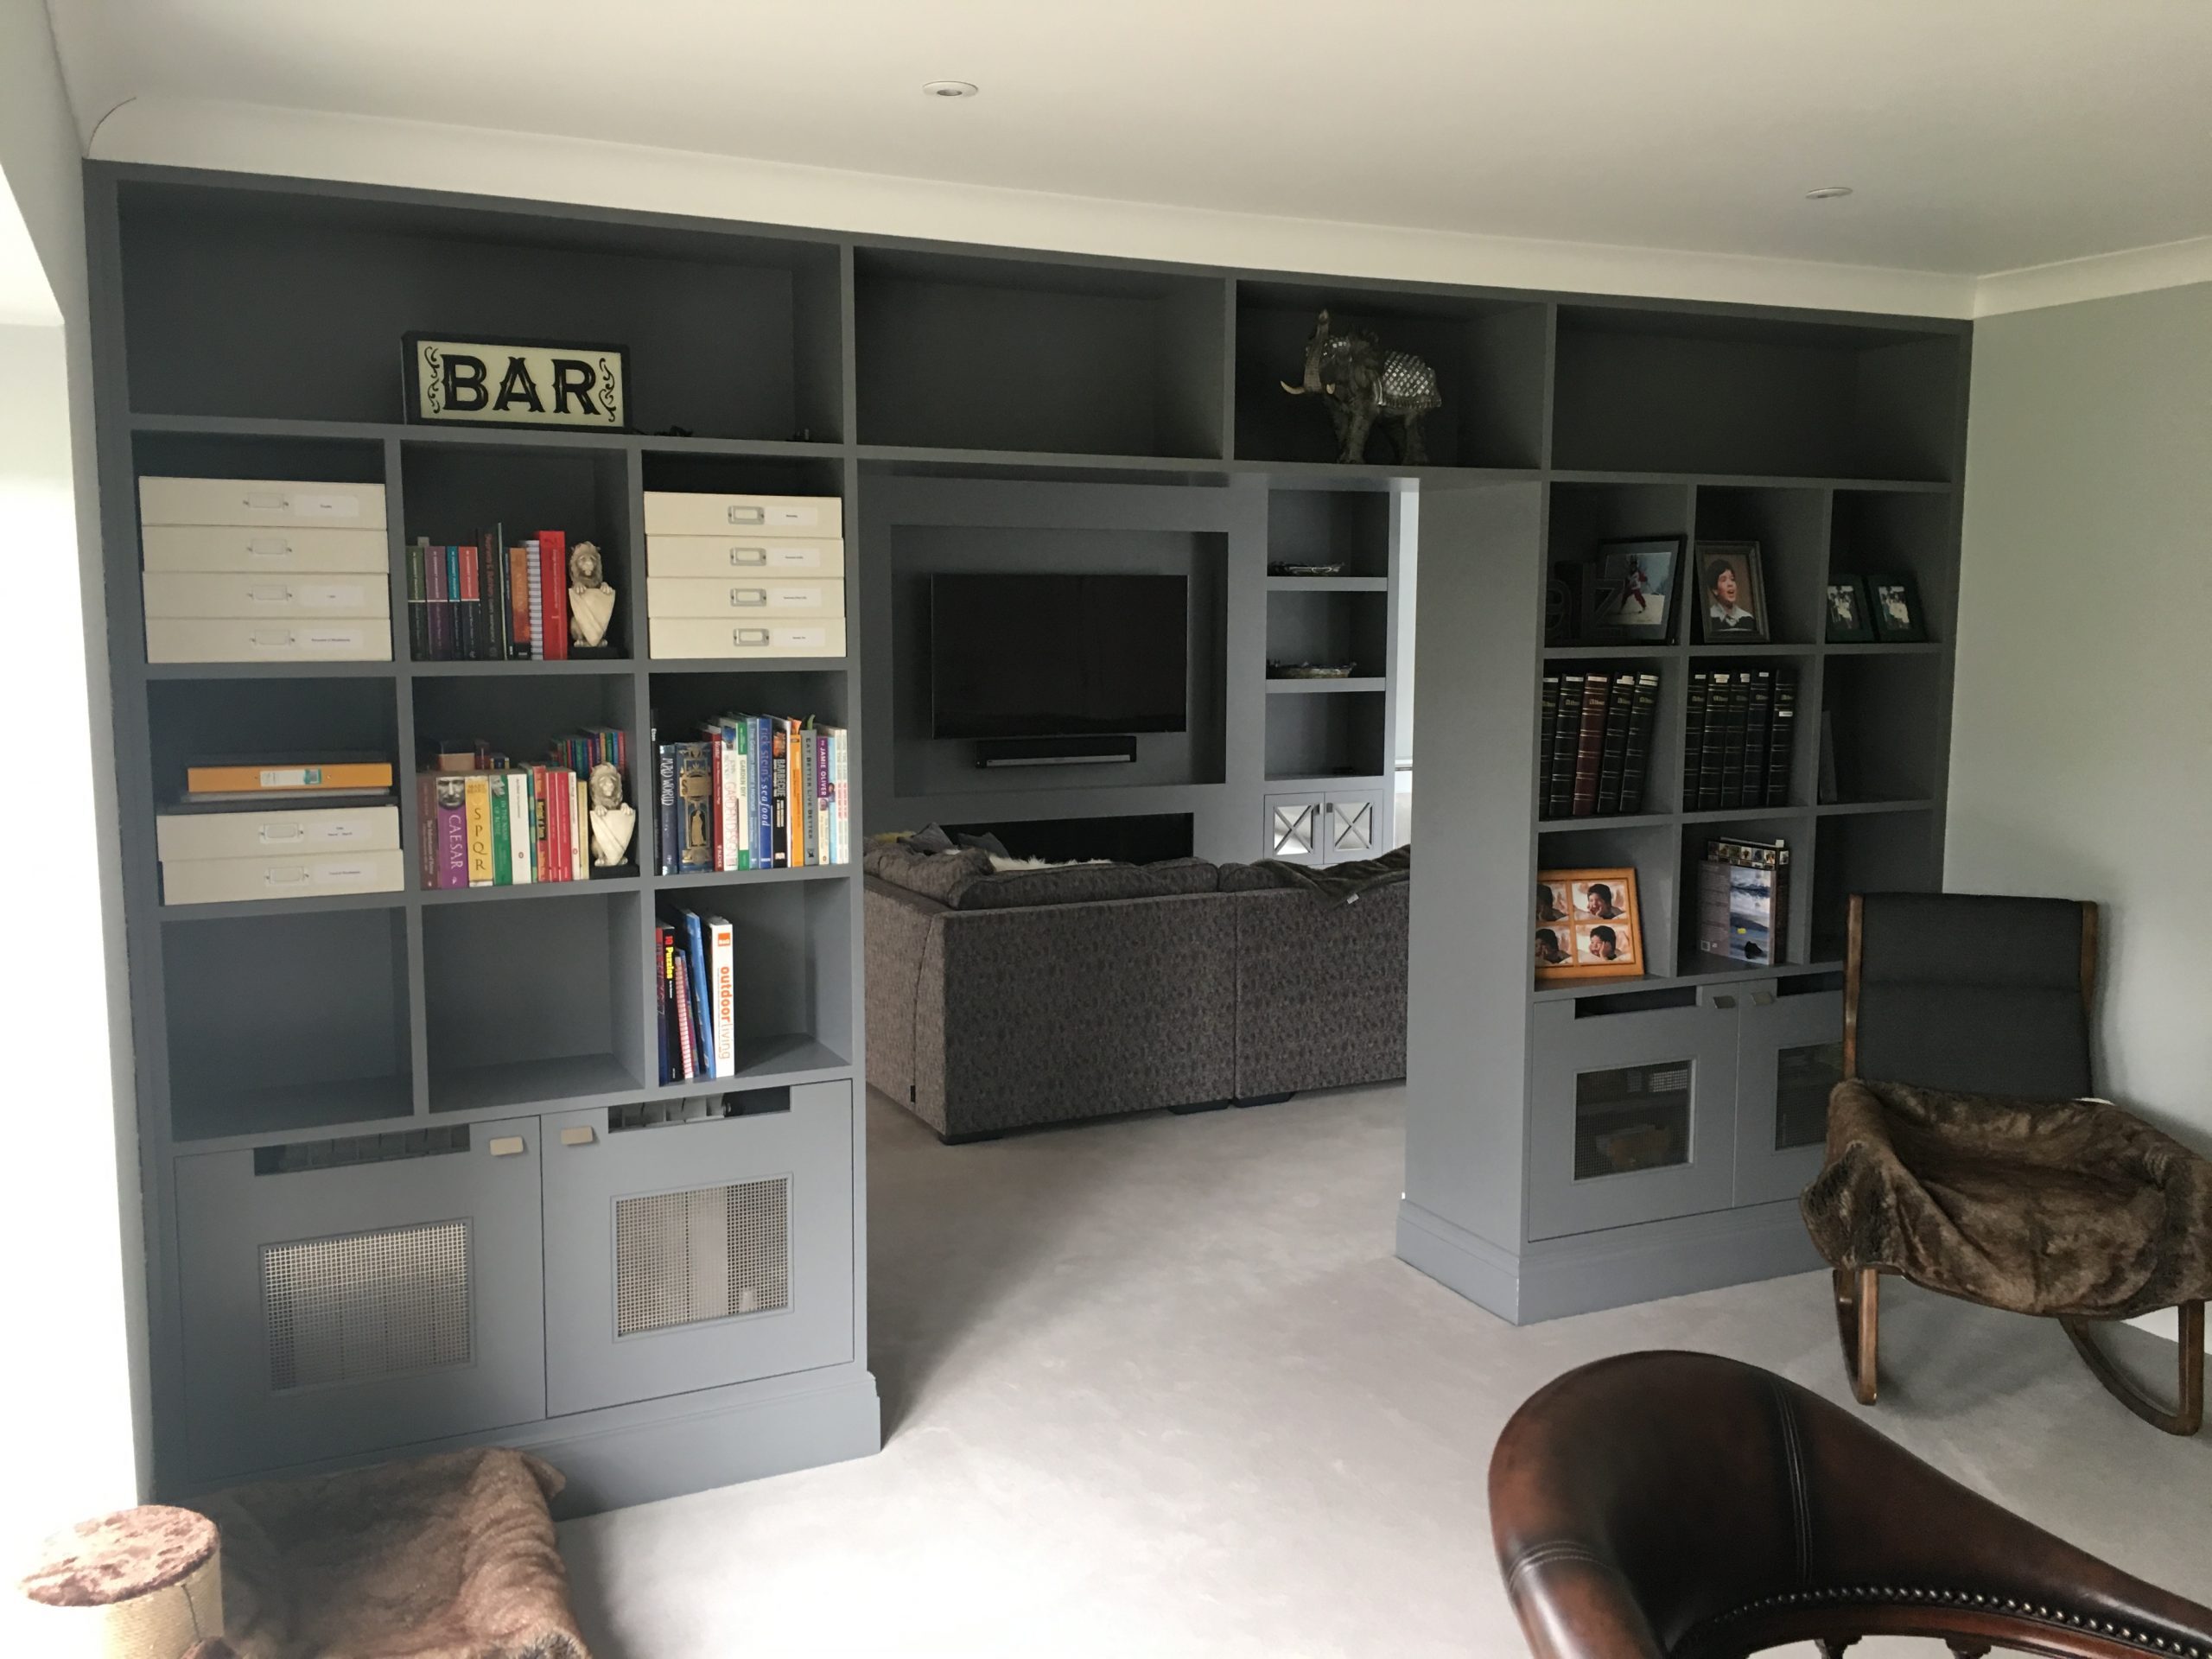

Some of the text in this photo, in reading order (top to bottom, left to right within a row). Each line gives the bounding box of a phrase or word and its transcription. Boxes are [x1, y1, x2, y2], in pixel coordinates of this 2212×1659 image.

[439, 353, 601, 416] BAR
[661, 757, 674, 806] MAD WORLD
[760, 728, 770, 826] rick stein's seafood
[777, 759, 785, 797] BARBECUE
[448, 815, 463, 869] CAESAR
[665, 947, 674, 979] Puzzles
